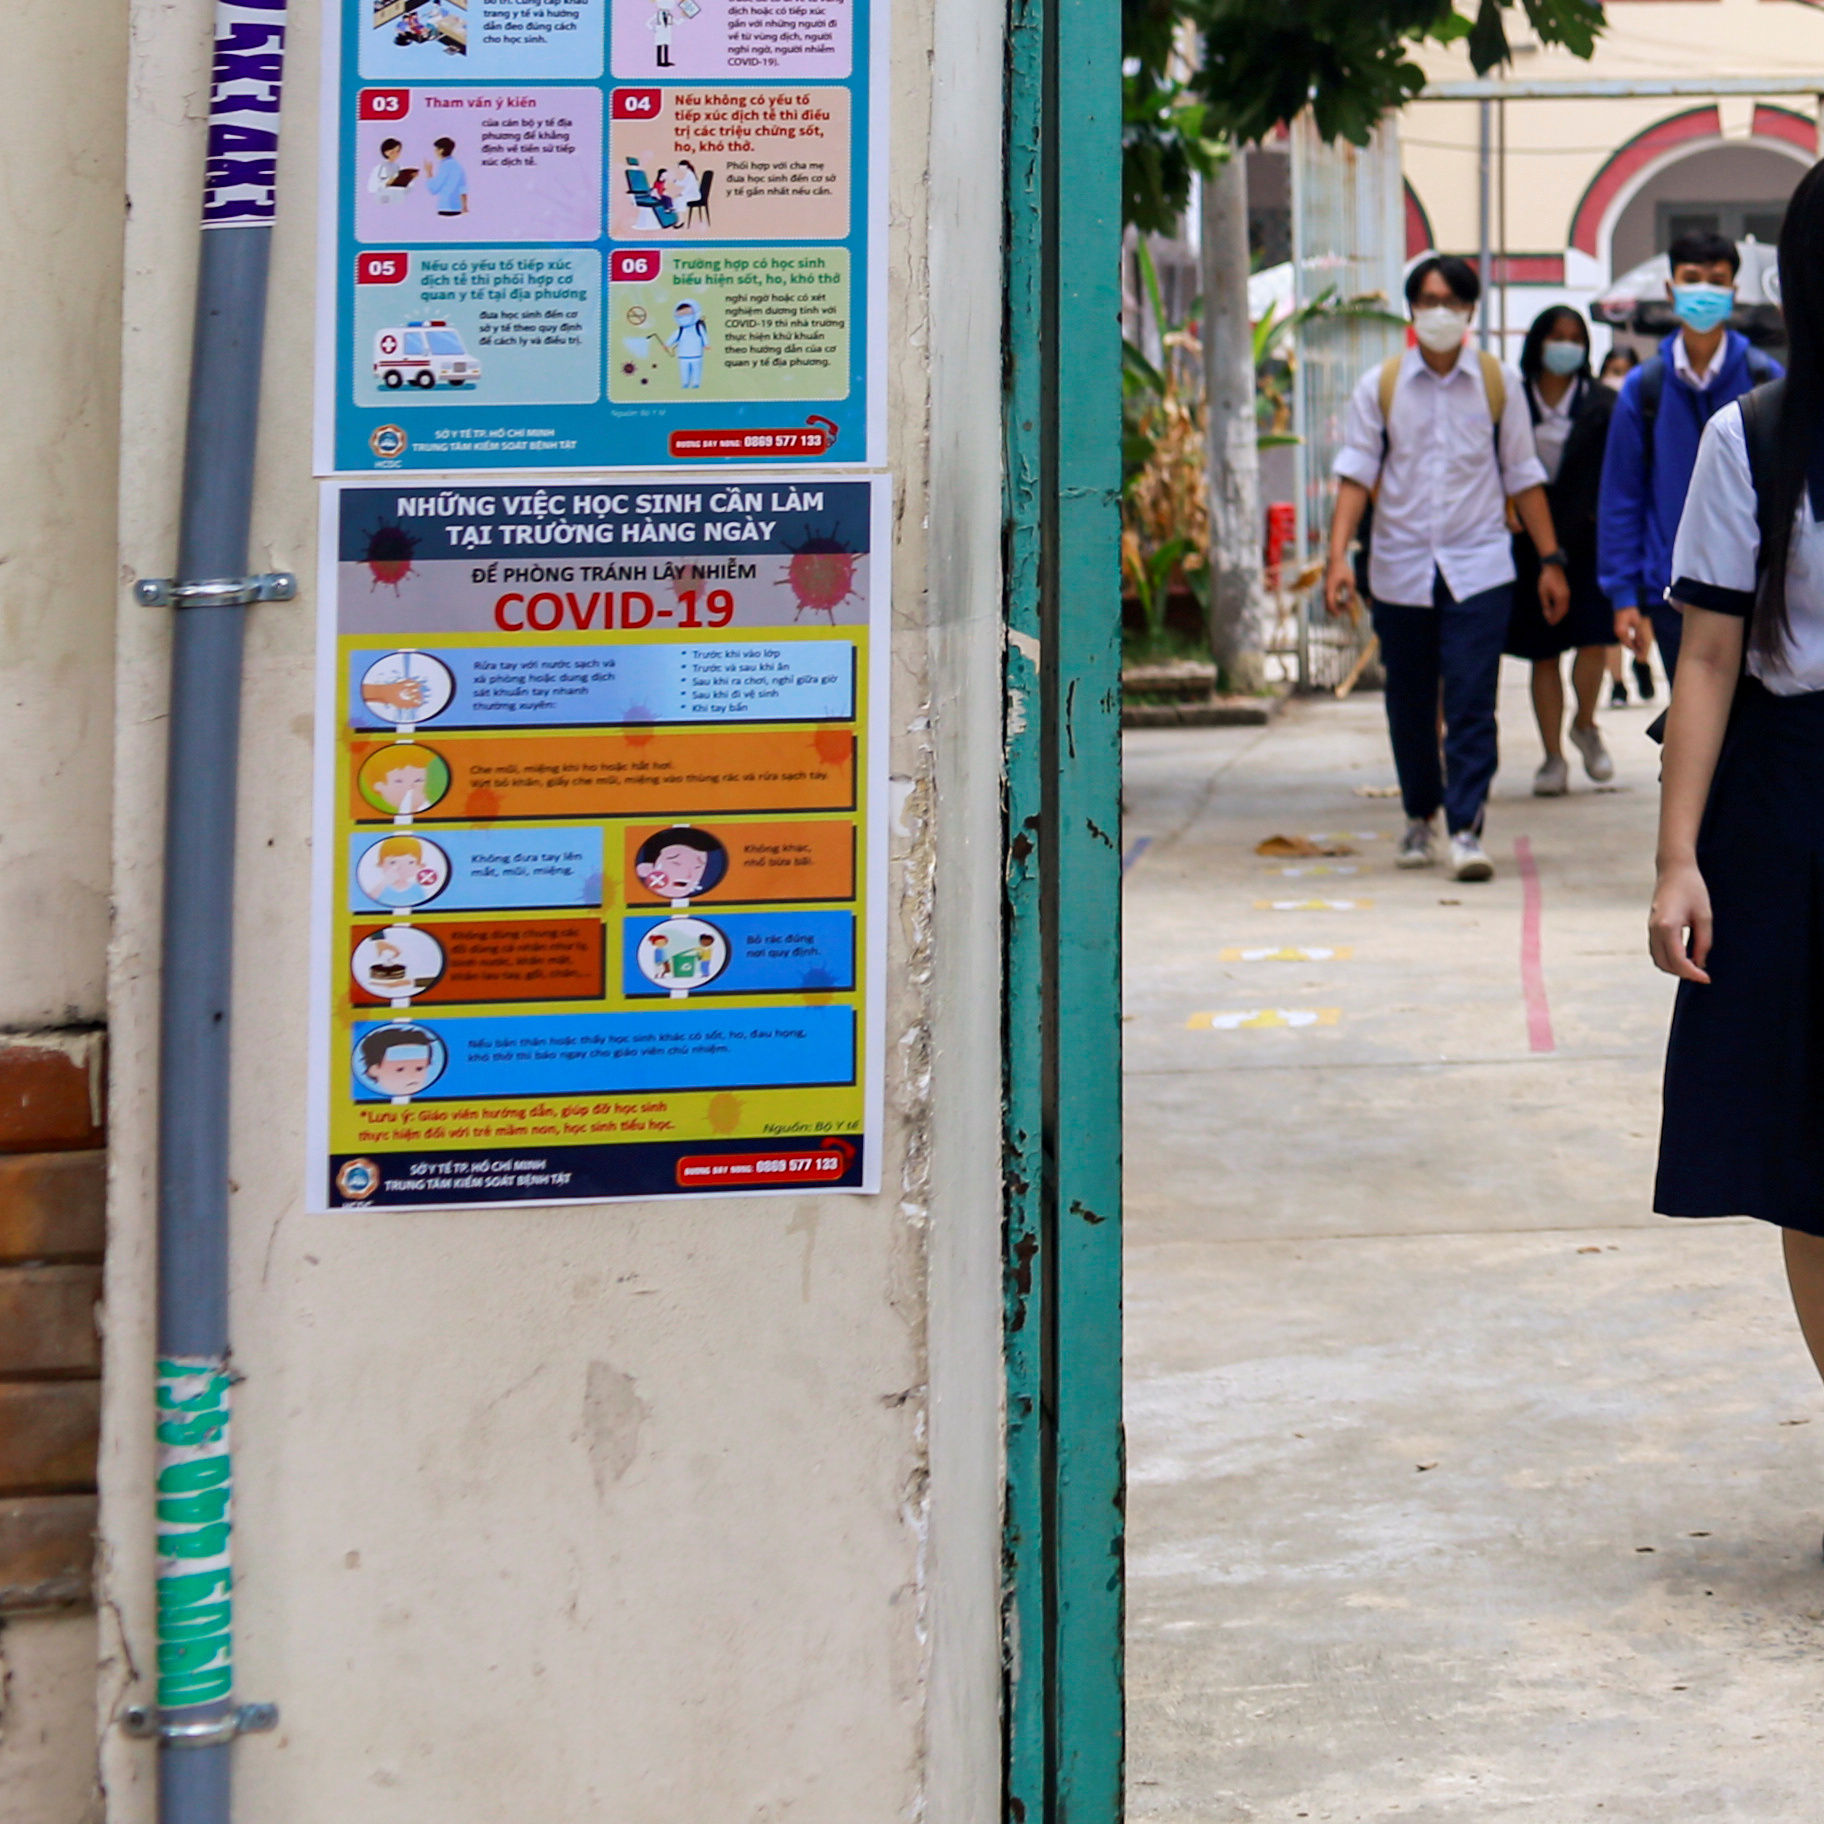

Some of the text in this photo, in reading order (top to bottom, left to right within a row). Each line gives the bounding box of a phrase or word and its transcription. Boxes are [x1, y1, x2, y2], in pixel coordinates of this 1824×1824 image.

[371, 95, 400, 112] 03
[424, 96, 537, 111] Tham vấn ý kiến
[624, 95, 652, 112] 04
[675, 93, 810, 110] Nếu không có yếu tố
[674, 110, 701, 123] tiếp
[702, 109, 728, 121] xúc
[731, 109, 759, 124] dịch
[762, 107, 776, 121] tễ
[779, 109, 801, 120] thì
[674, 124, 824, 139] trị các triệu chứng sốt,
[674, 140, 755, 154] ho, khó thở.
[368, 259, 396, 276] 05
[621, 258, 648, 274] 06
[775, 435, 798, 447] 577
[800, 434, 823, 447] 133
[398, 486, 823, 518] NHỮNG VIỆC HỌC SINH CẦN LÀM
[446, 515, 776, 550] TẠI TRƯỜNG HÀNG NGÀY
[472, 558, 755, 583] ĐỂ PHÒNG TRÁNH LÂY NHIỄM
[493, 590, 736, 633] COVID-19
